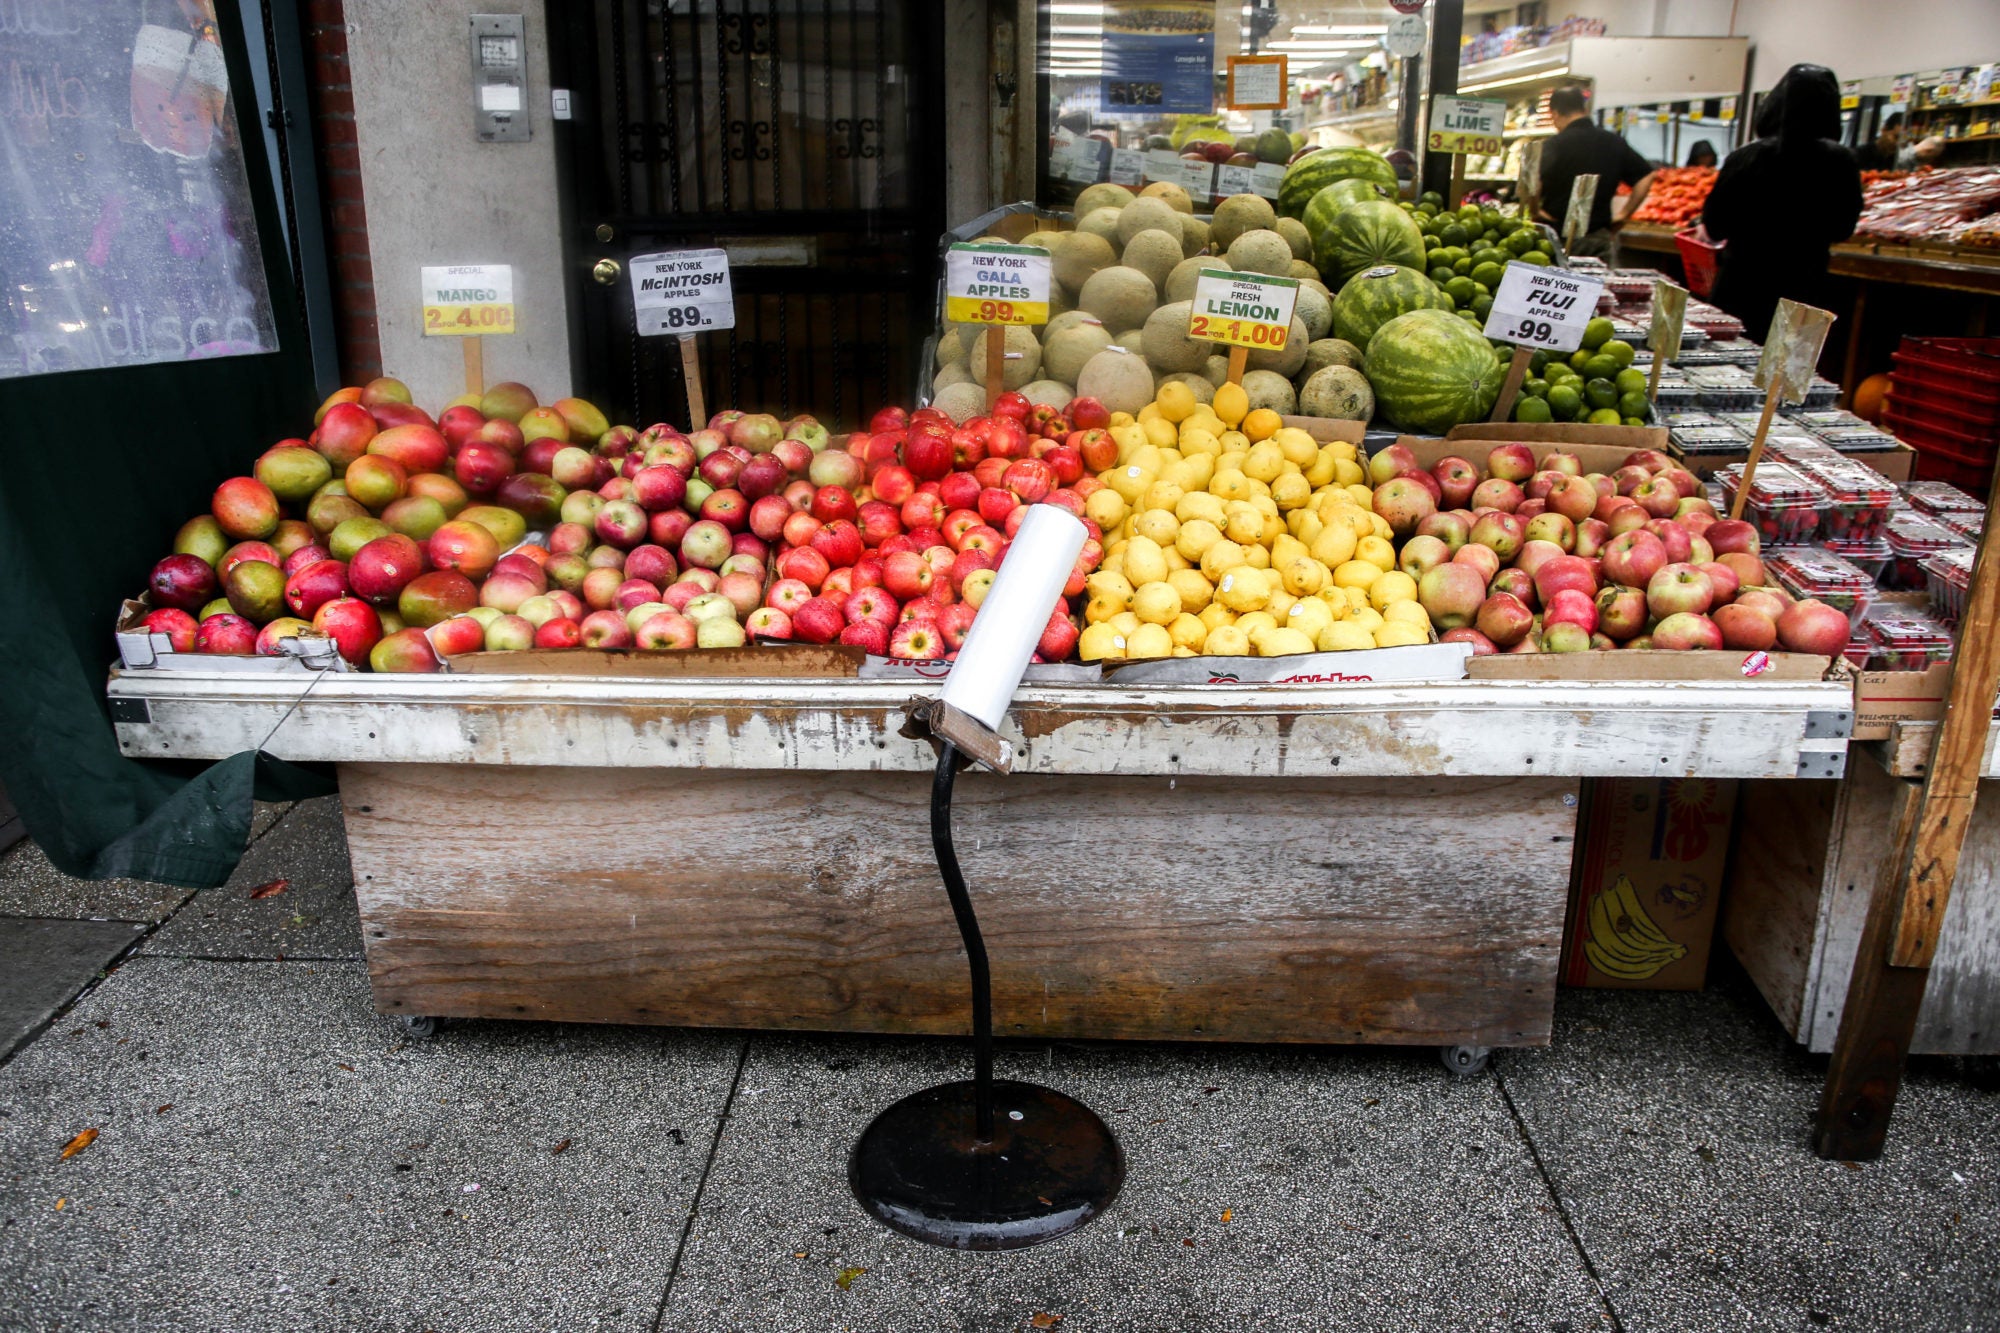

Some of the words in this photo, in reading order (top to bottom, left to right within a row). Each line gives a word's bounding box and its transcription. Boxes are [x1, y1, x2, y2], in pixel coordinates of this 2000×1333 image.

[1444, 113, 1491, 131] LIME
[1430, 133, 1443, 149] 3
[1456, 136, 1498, 154] 1.00
[448, 266, 483, 275] SPECIAL
[655, 262, 676, 274] NEW
[676, 261, 703, 272] YORK
[972, 256, 997, 266] NEW
[997, 256, 1027, 268] YORK
[641, 272, 724, 291] McINTOSH
[976, 270, 1022, 284] GALA
[1232, 281, 1262, 291] SPECIAL
[1530, 275, 1554, 287] NEW
[1554, 279, 1580, 293] YORK
[437, 289, 497, 302] MANGO
[664, 289, 701, 299] APPLES
[966, 284, 1030, 299] APPLES
[1231, 291, 1261, 302] FRESH
[1526, 289, 1577, 310] FUJI
[427, 309, 442, 328] 2
[456, 306, 511, 328] 4.00
[661, 306, 701, 328] .89
[971, 301, 1014, 322] .99
[1207, 299, 1279, 321] LEMON
[1528, 307, 1566, 321] APPLES
[1190, 316, 1208, 336] 2
[1228, 321, 1286, 346] 1.00
[1508, 320, 1552, 342] .99
